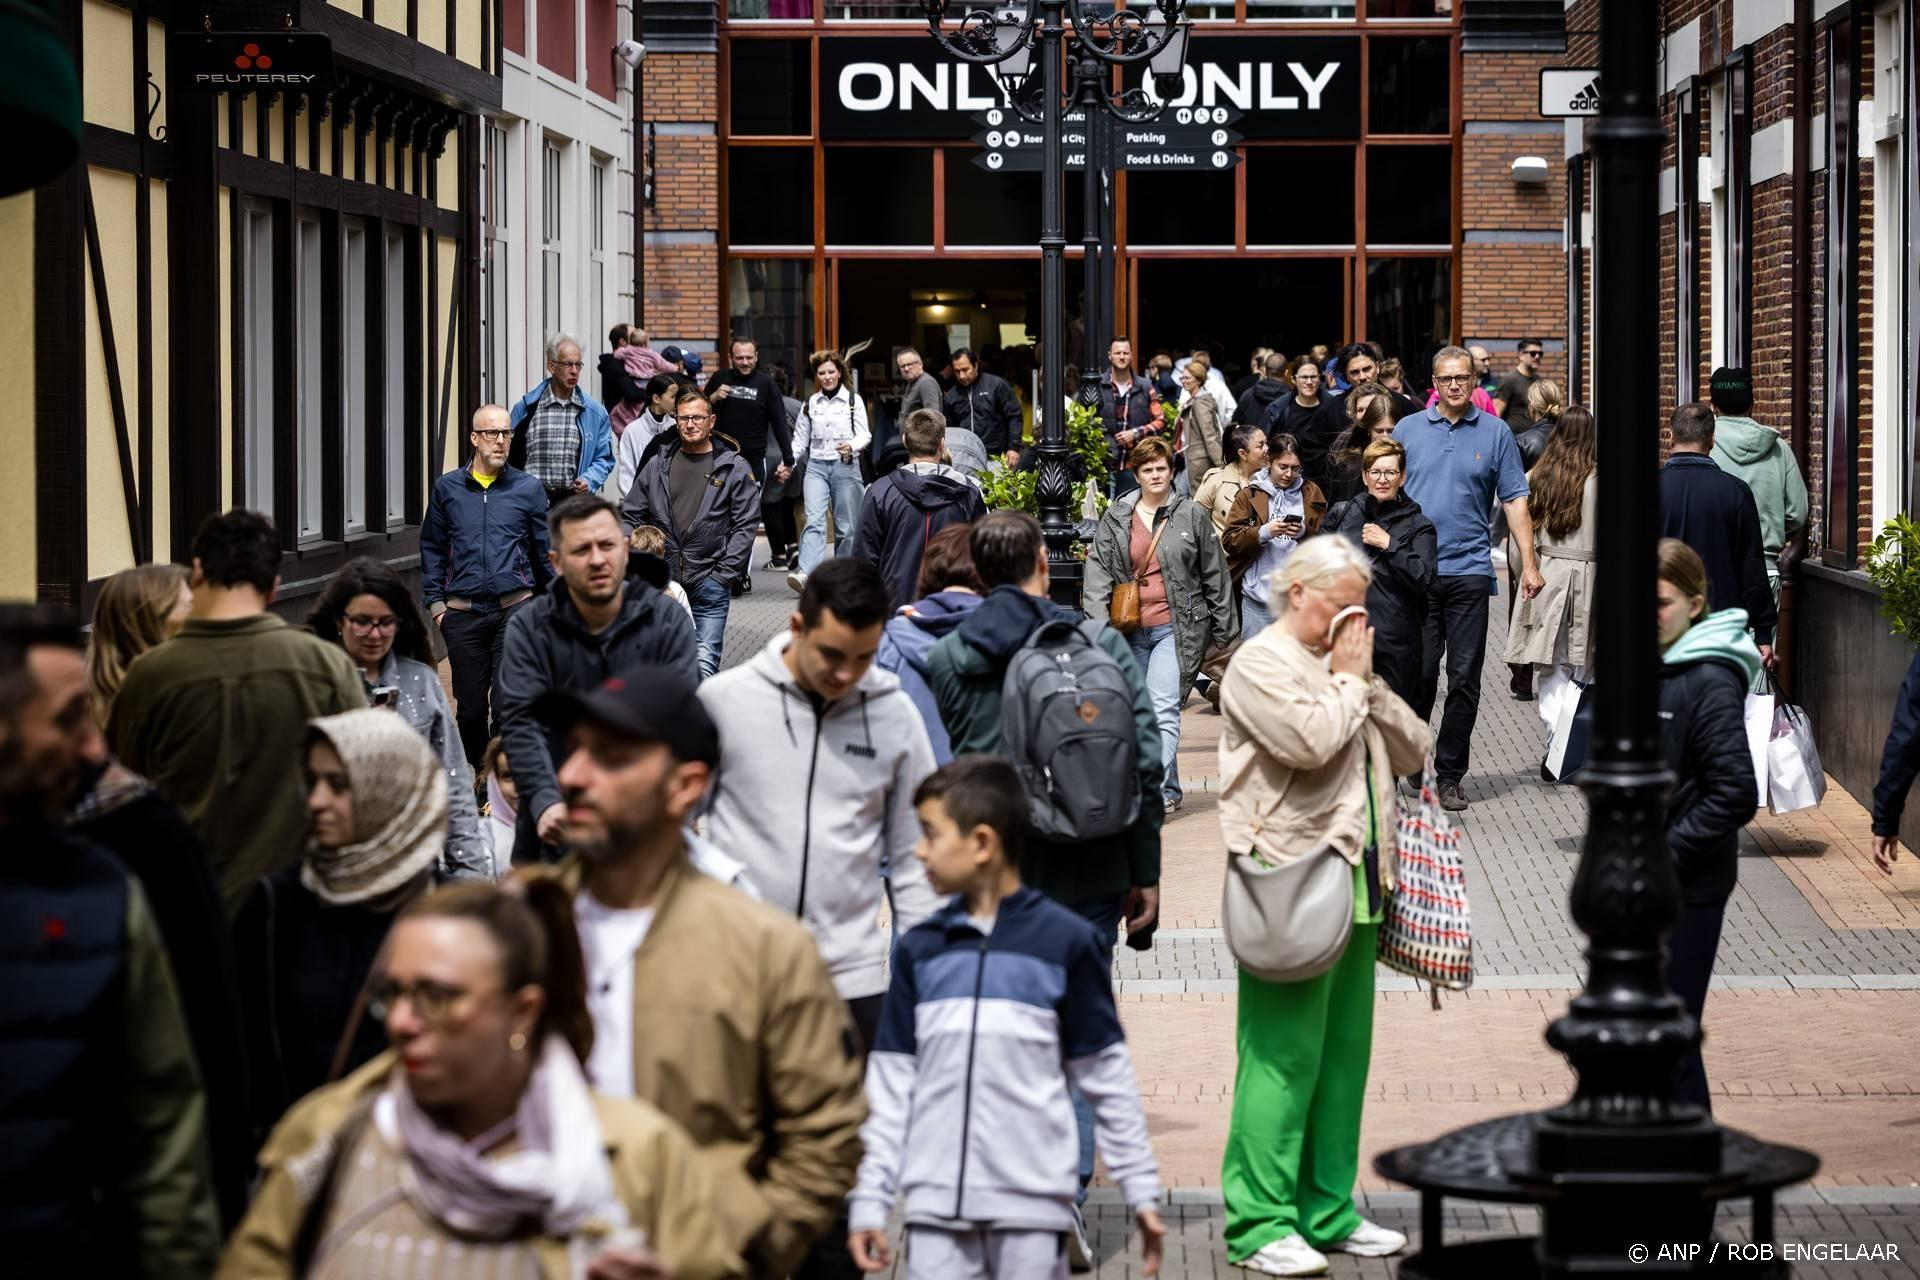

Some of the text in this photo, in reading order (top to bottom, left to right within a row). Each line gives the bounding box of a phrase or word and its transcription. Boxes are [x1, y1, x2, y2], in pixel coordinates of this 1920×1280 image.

[196, 74, 316, 83] PEUTEREY
[1142, 62, 1341, 111] ONLY
[1126, 132, 1166, 145] Parking
[1126, 154, 1195, 164] Food & Drinks
